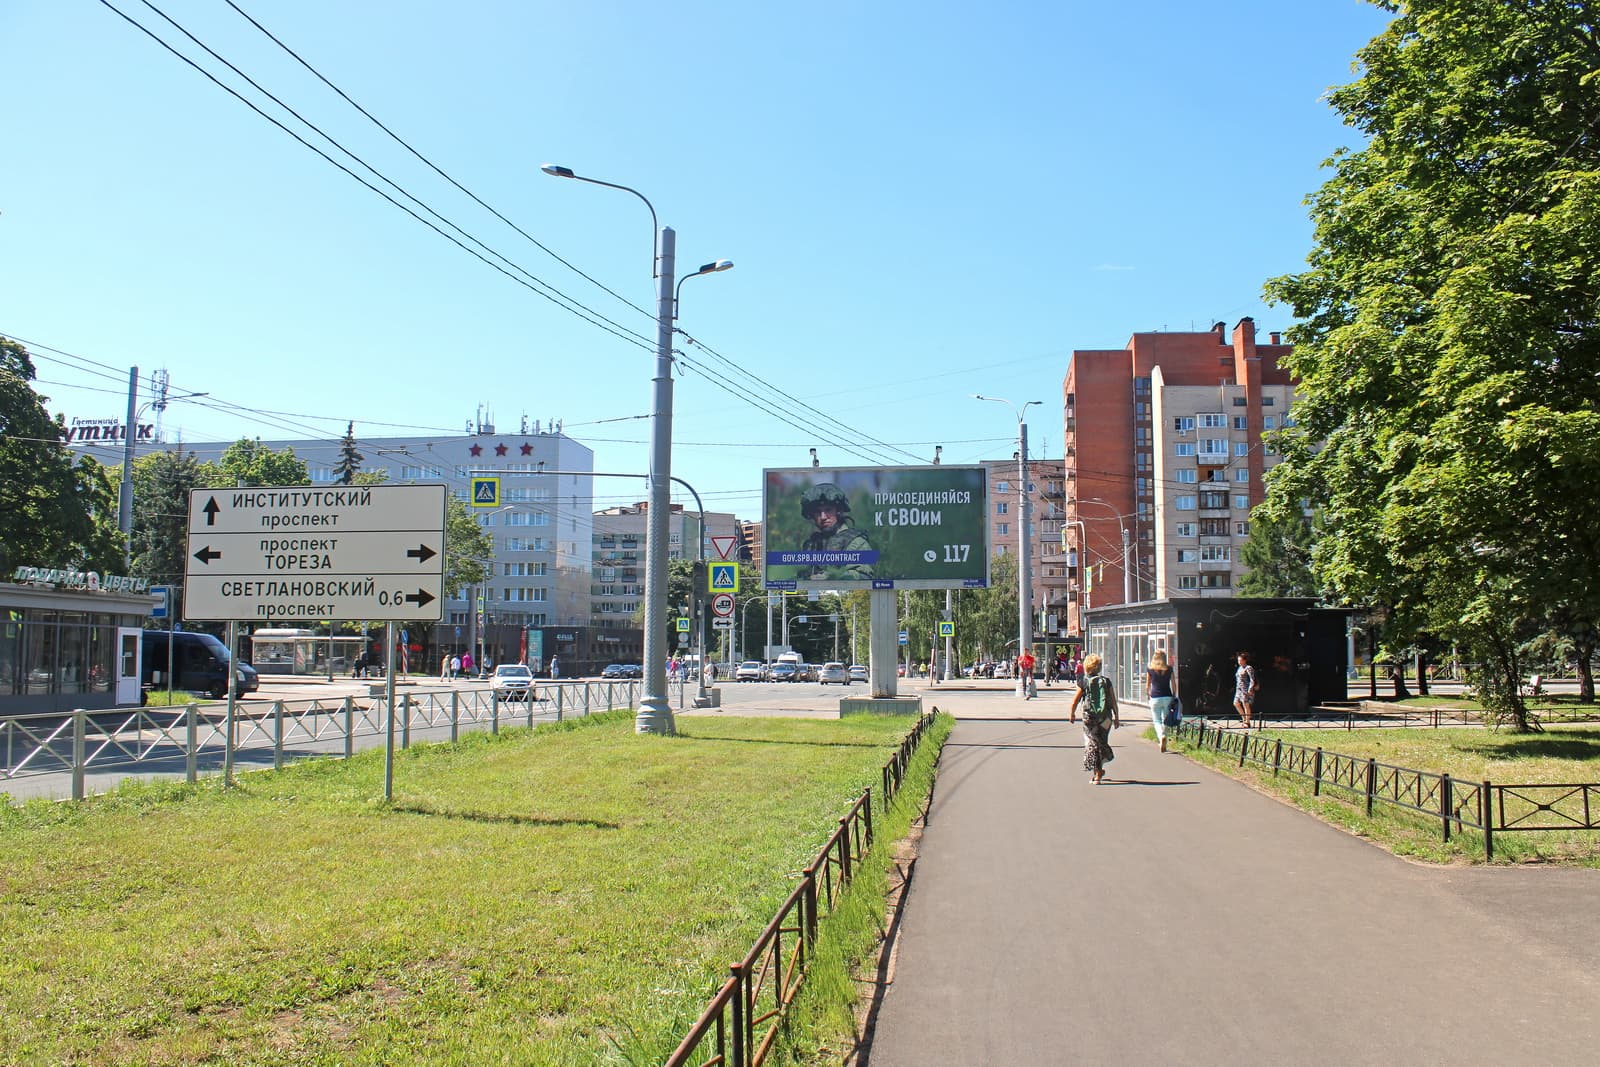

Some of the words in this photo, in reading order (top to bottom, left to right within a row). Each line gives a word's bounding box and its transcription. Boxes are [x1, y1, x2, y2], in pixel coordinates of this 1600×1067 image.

[71, 415, 119, 426] Гостиница
[233, 487, 372, 508] ИНСТИТУТСКИЙ
[874, 489, 971, 506] ПРИСОЕДИНЯЙСЯ
[261, 513, 339, 530] проспект
[888, 507, 942, 527] СВОим
[260, 538, 338, 554] проспект
[943, 544, 971, 563] 117
[264, 554, 332, 570] ТОРЕЗА
[782, 552, 861, 563] GOV.SPB.RU/CONTRACT
[13, 565, 85, 586] ПОДАРКИ
[103, 575, 148, 592] ЦВЕТЫ
[221, 577, 375, 597] СВЕТЛАНОВСКИЙ
[378, 590, 404, 608] 0,6
[256, 603, 336, 619] проспект
